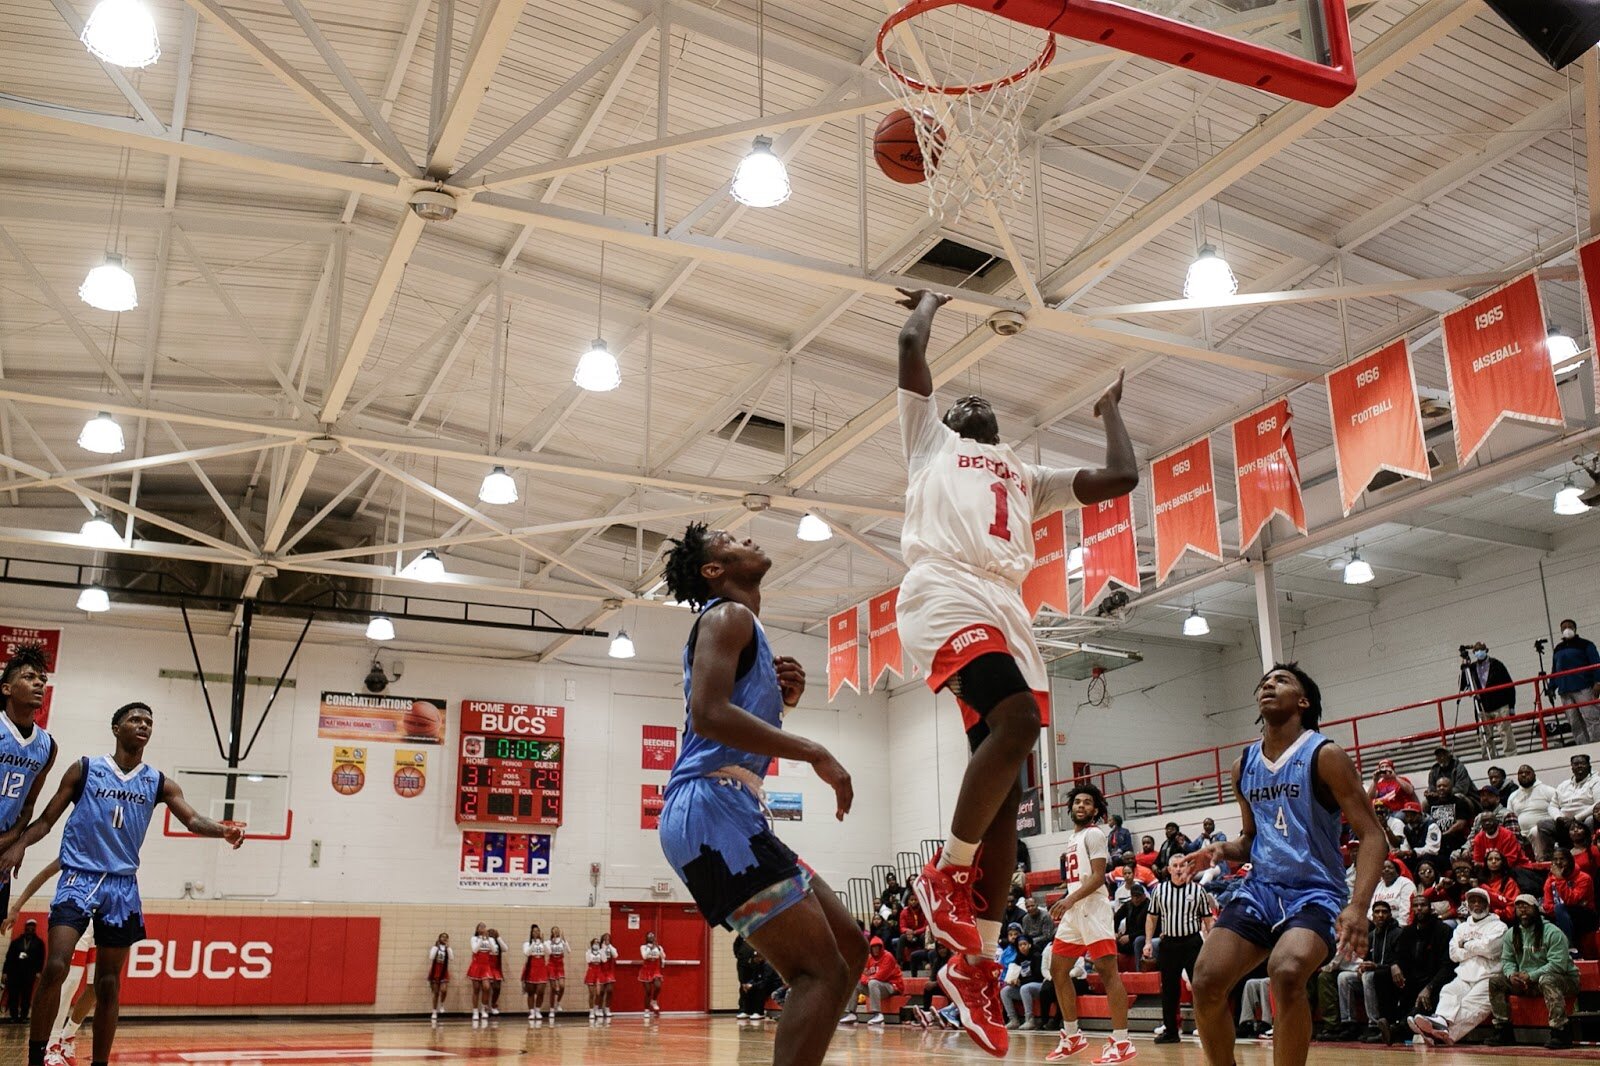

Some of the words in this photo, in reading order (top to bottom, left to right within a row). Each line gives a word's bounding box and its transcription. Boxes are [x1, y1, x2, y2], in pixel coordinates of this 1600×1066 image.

[1475, 305, 1504, 330] 1965
[1472, 342, 1521, 373] BASEBALL
[1356, 366, 1380, 388] 1966
[1351, 398, 1393, 426] FOOTBALL
[1256, 416, 1277, 436] 1968
[1172, 459, 1191, 477] 1969
[1239, 463, 1256, 477] BOYS
[1257, 447, 1284, 468] BASKET
[1156, 500, 1173, 515] BOYS
[1173, 482, 1212, 507] BASKETBALL
[989, 482, 1011, 542] 1
[1097, 518, 1130, 541] BASKETBALL
[12, 628, 39, 637] STATE
[951, 628, 989, 654] BUCS
[325, 694, 413, 711] CONGRATULATIONS
[470, 702, 505, 713] HOME
[511, 705, 528, 714] OF
[534, 706, 558, 717] THE
[481, 713, 546, 734] BUCS
[497, 738, 540, 760] 0:05
[643, 738, 675, 748] BEECHER
[466, 757, 488, 765] HOME
[534, 761, 558, 769] GUEST
[1, 771, 26, 799] 12
[468, 766, 491, 785] 31
[536, 770, 560, 788] 29
[95, 787, 146, 805] HAWKS
[1249, 783, 1300, 802] HAWKS
[464, 793, 477, 813] 2
[547, 798, 559, 814] 4
[112, 805, 124, 829] 11
[1274, 805, 1288, 837] 4
[657, 882, 669, 891] EXIT
[127, 939, 273, 979] BUCS
